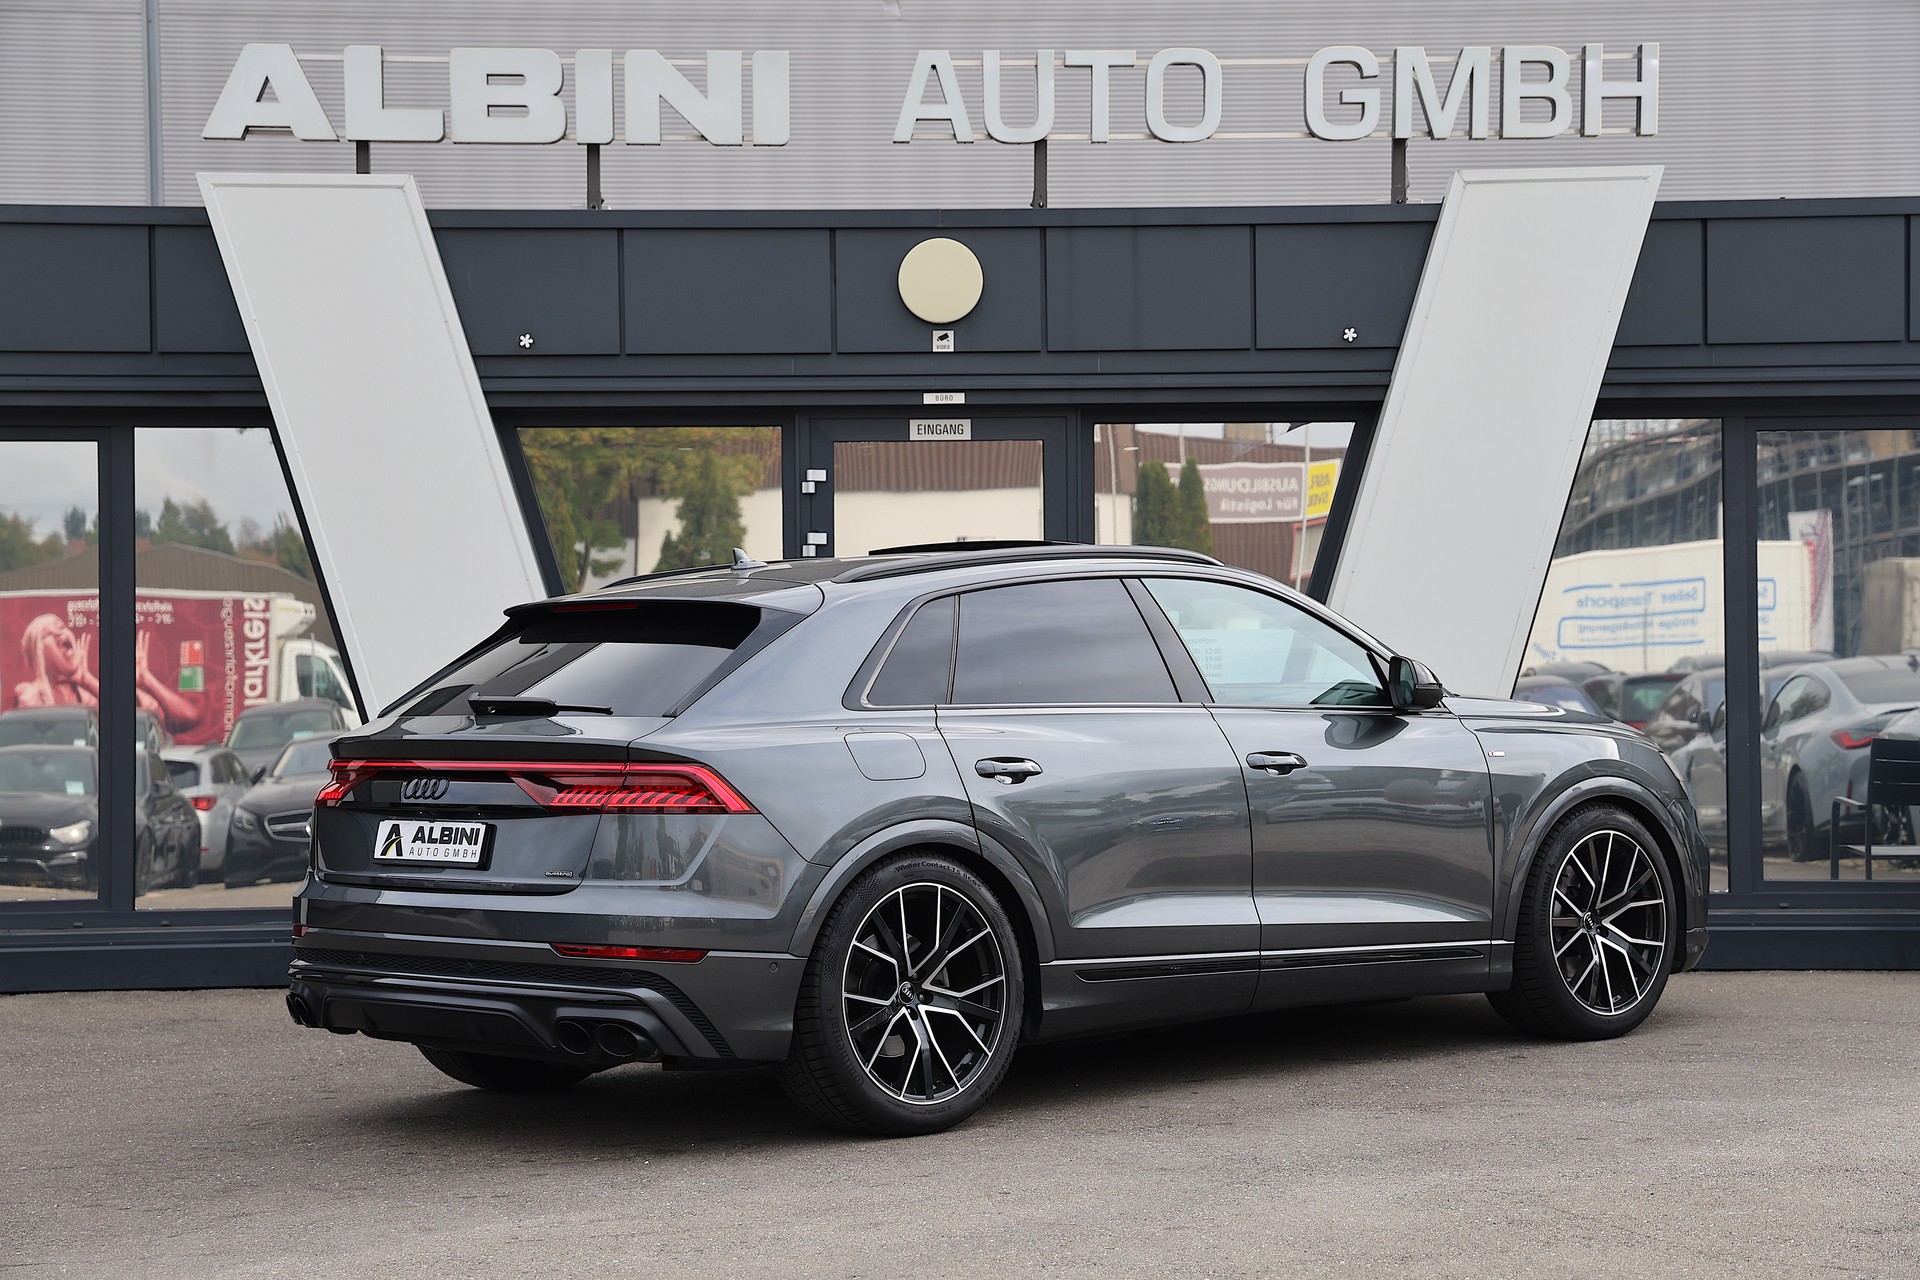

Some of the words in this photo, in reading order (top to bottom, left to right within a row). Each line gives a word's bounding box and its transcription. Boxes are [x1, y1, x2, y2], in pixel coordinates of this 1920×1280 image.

[202, 42, 791, 147] ALBINI
[892, 47, 1223, 144] AUTO
[1303, 42, 1661, 141] GMBH
[935, 394, 954, 402] BÜRO
[917, 424, 964, 435] EINGANG
[411, 825, 481, 846] ALBINI
[409, 846, 439, 857] AUTO
[444, 848, 478, 859] GMBH
